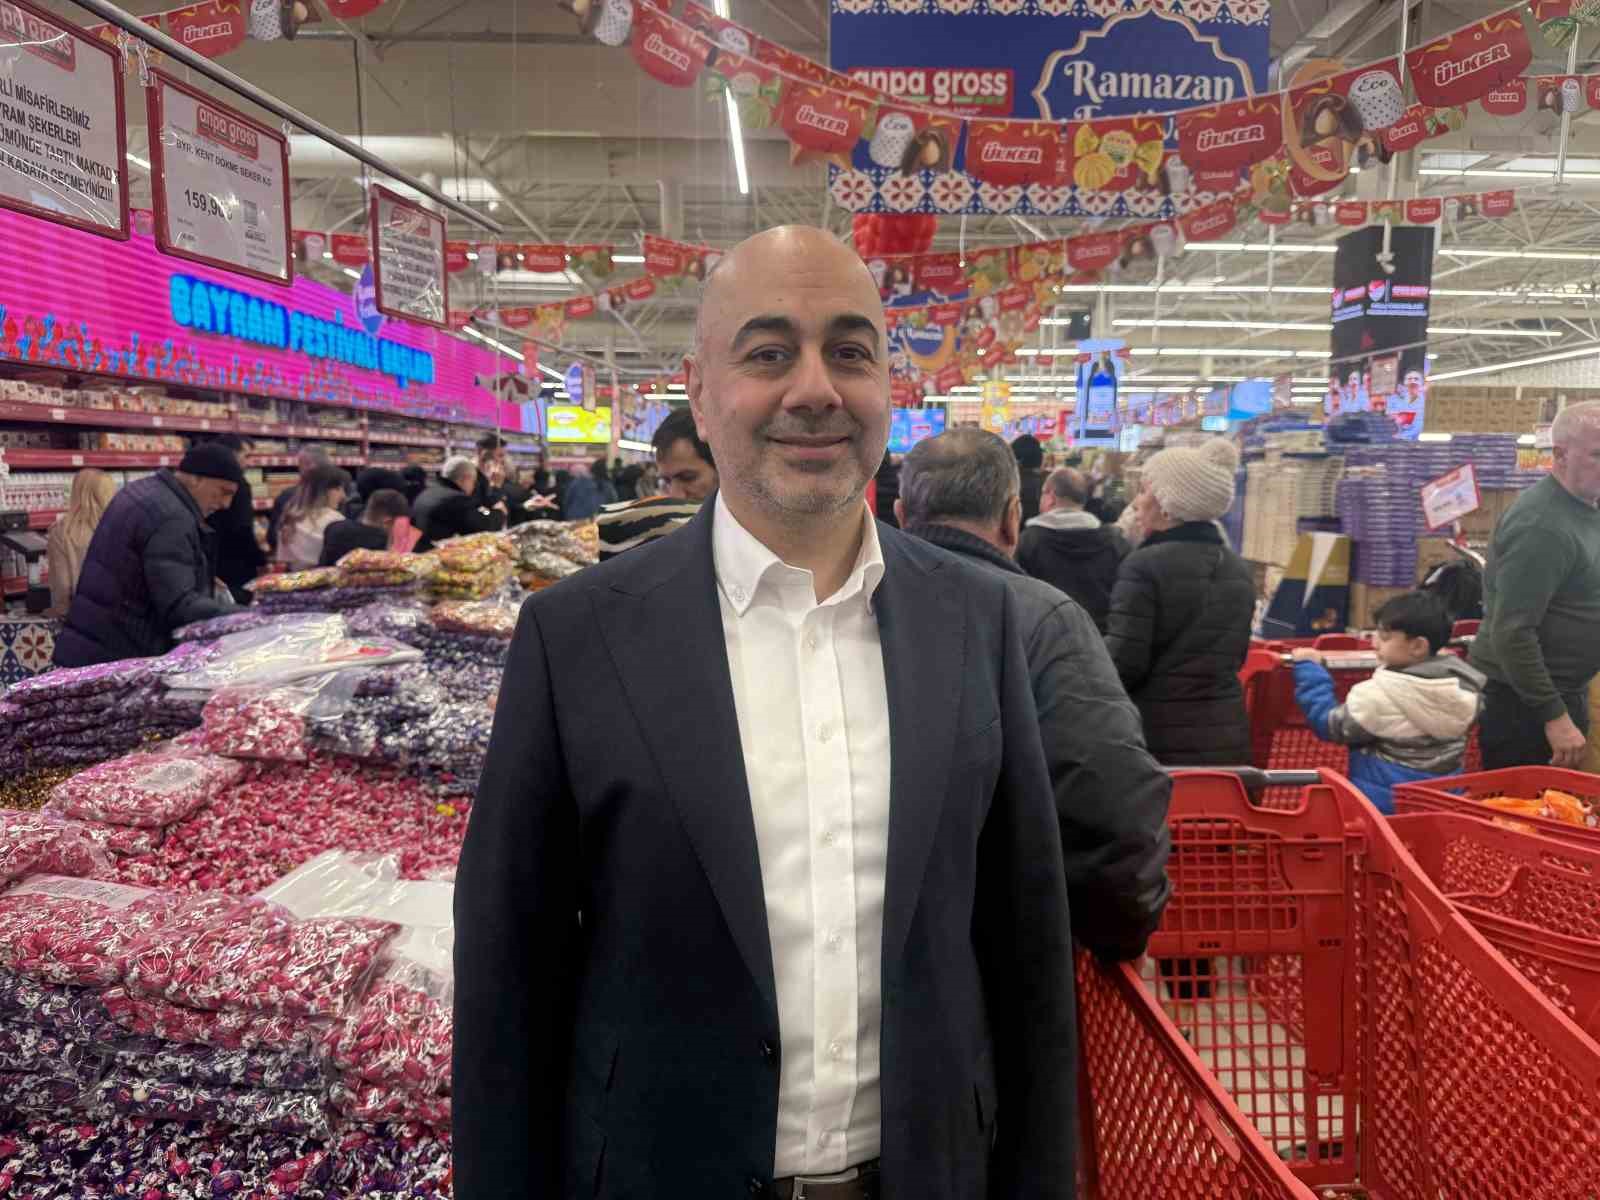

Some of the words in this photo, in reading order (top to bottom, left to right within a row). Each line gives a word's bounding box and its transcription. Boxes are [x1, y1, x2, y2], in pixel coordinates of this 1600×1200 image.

[184, 22, 232, 43] ÜLKER
[644, 33, 690, 71] ÜLKER
[1434, 43, 1511, 86] ÜLKER
[933, 71, 1008, 104] gross
[1064, 61, 1235, 103] Ramazan
[1359, 76, 1388, 92] Eco
[15, 84, 91, 130] MİSAFİRLERİMİZ
[796, 104, 848, 136] ÜLKER
[28, 113, 81, 148] ŞEKERLERİ
[229, 123, 256, 148] gross
[1197, 125, 1265, 151] ÜLKER
[981, 141, 1041, 164] ÜLKER
[169, 274, 288, 348] BAYRAM
